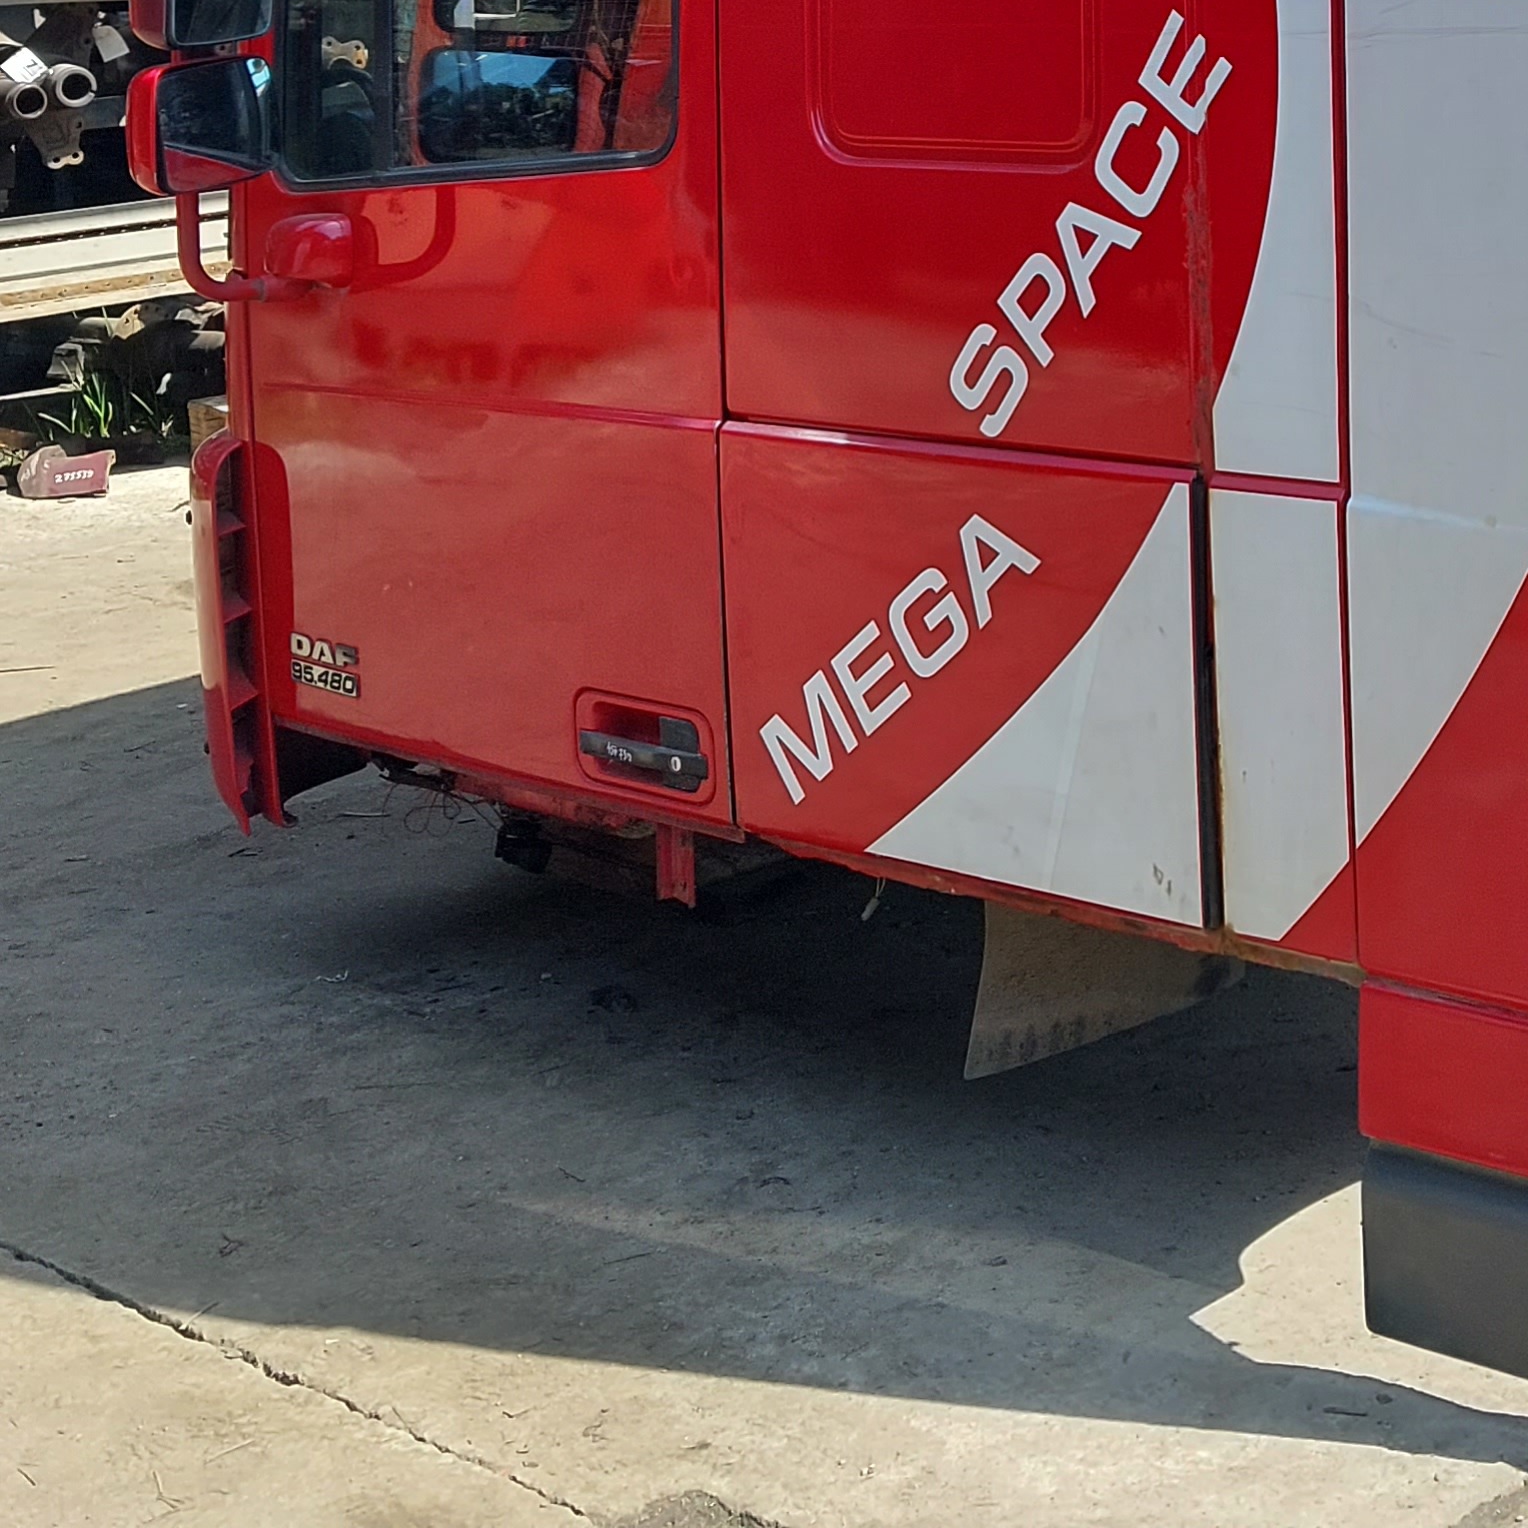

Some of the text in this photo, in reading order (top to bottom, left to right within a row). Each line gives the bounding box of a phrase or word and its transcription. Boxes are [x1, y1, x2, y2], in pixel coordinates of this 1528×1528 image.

[949, 8, 1233, 438] SPACE
[290, 632, 357, 667] DAF
[291, 661, 356, 694] 95.480
[758, 512, 1041, 806] MEGA
